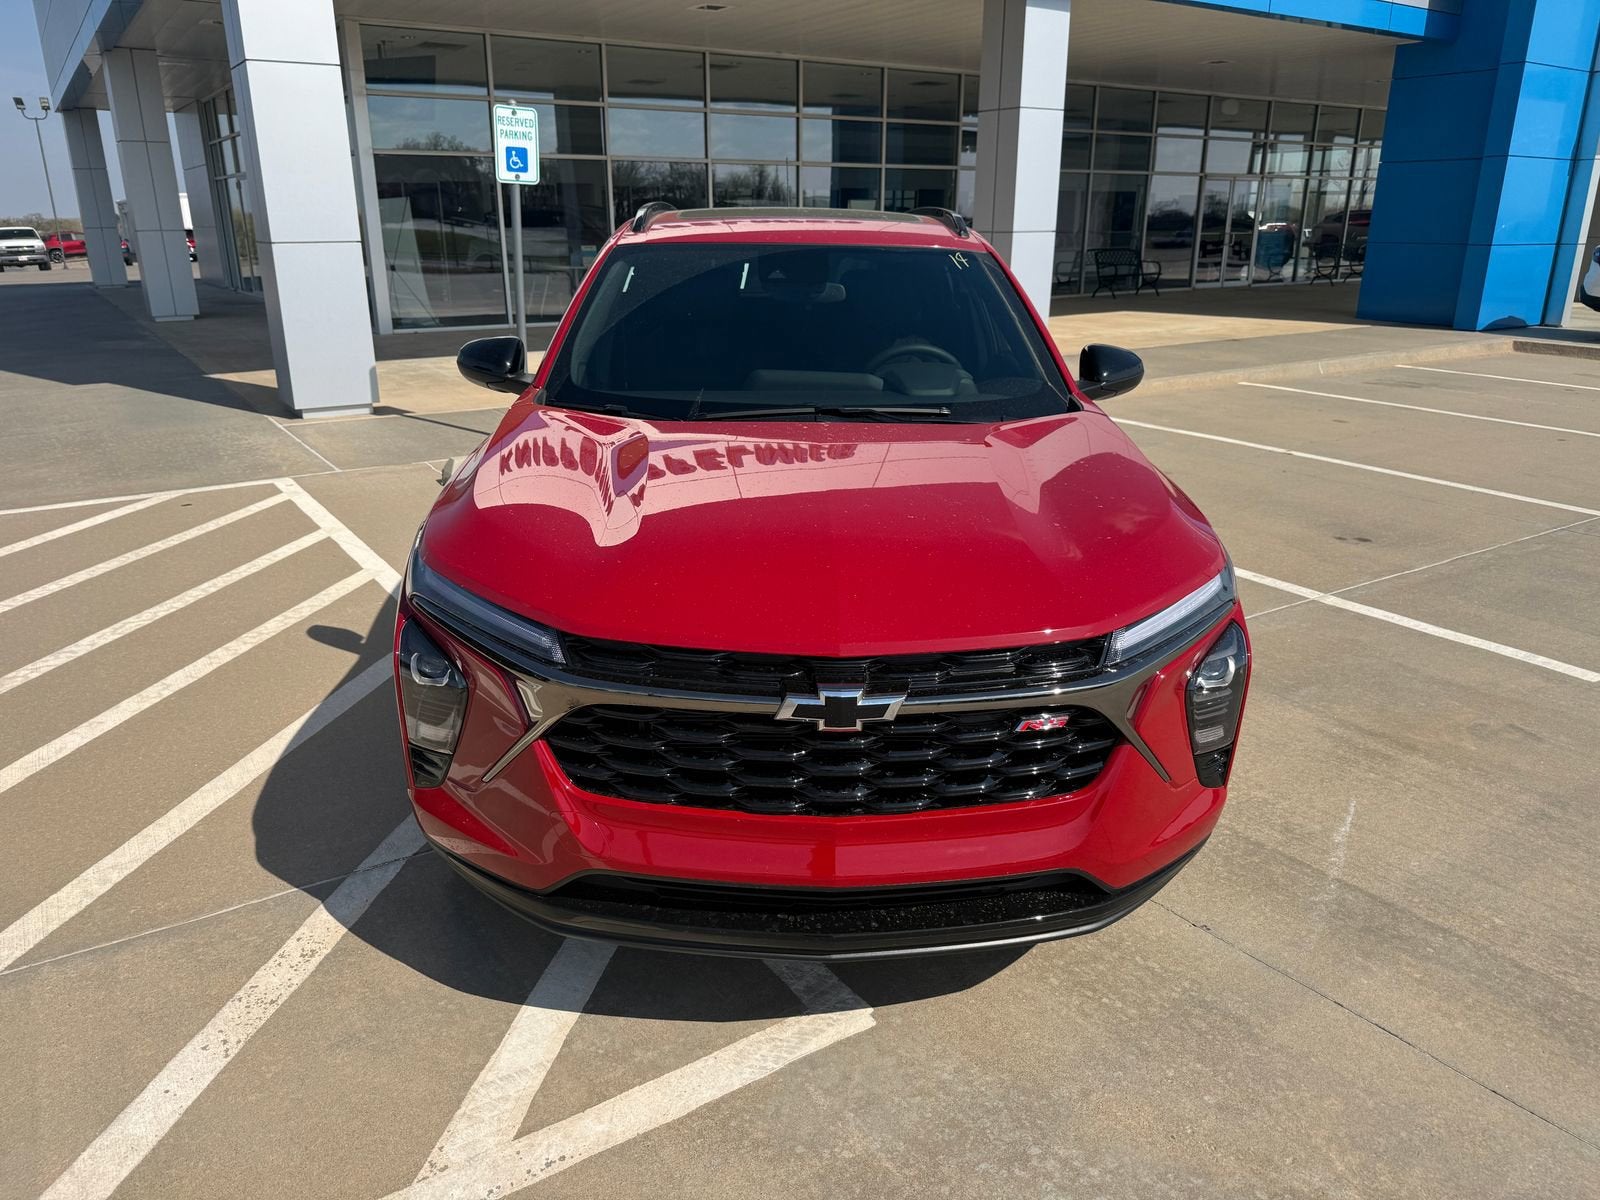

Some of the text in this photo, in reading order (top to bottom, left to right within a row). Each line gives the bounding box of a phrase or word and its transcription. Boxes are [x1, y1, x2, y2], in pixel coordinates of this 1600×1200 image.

[497, 115, 535, 129] RESERVED
[499, 129, 533, 141] PARKING
[1015, 714, 1069, 732] RS
